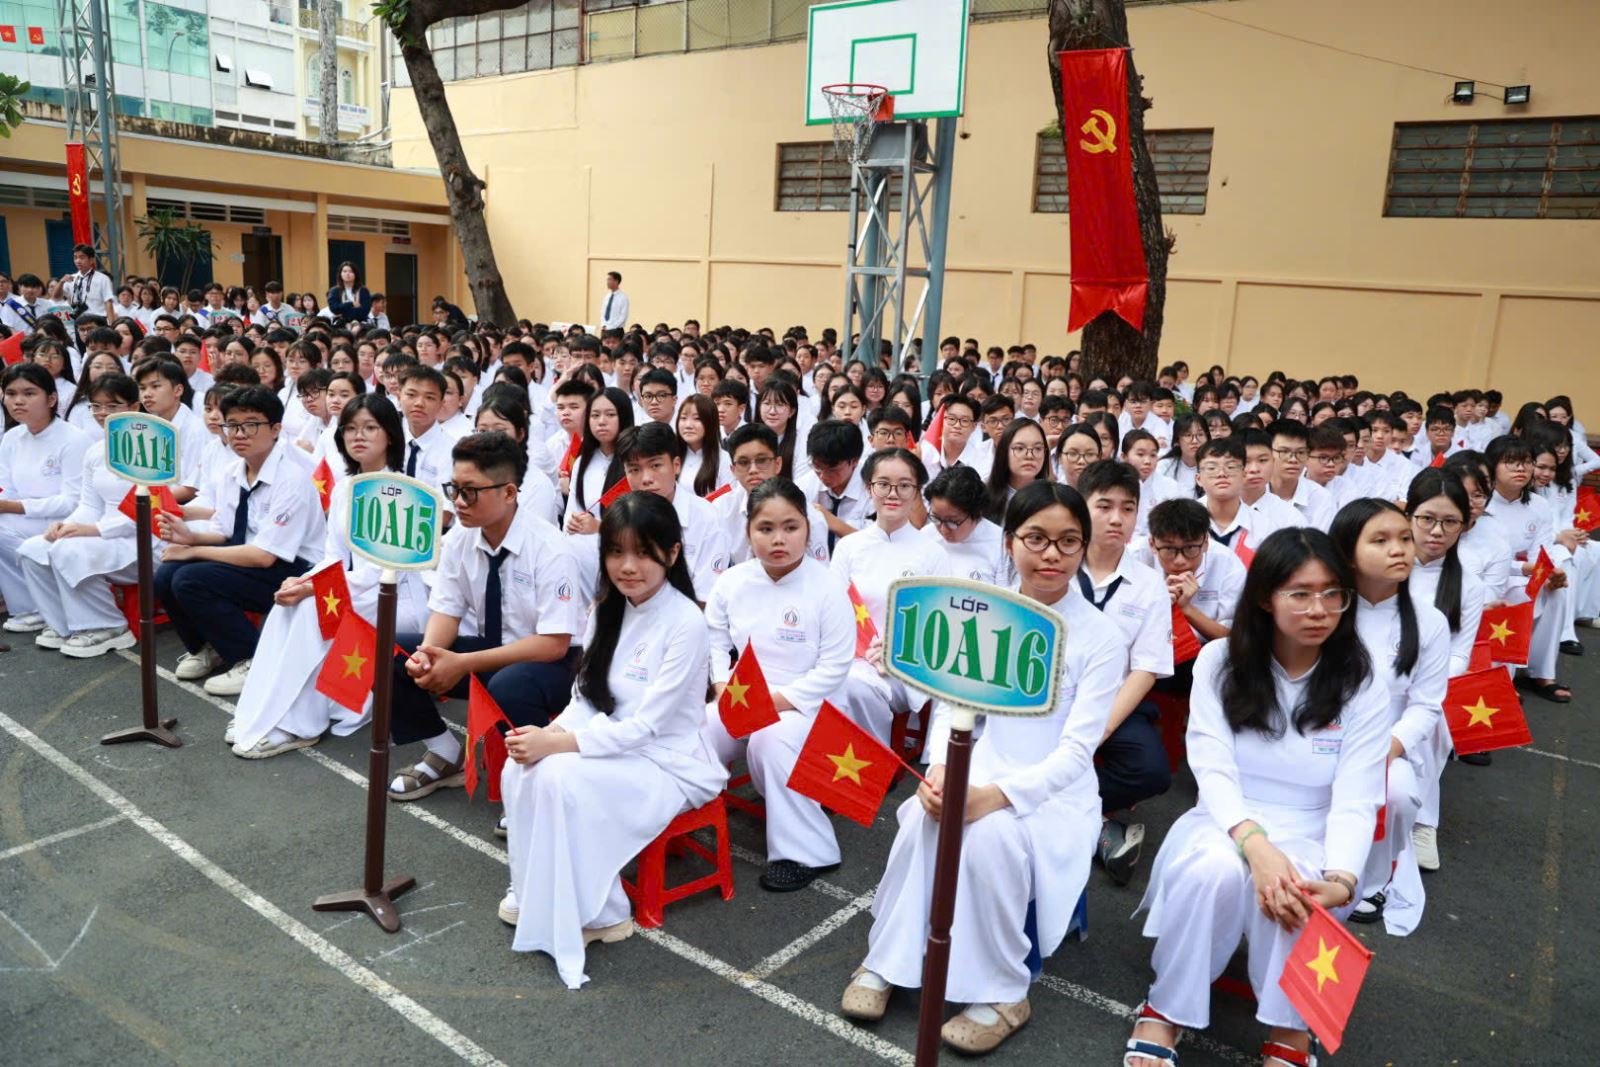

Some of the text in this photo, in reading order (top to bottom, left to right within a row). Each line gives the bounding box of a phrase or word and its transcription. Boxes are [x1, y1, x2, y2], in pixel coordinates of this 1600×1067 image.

[111, 430, 173, 472] 10A14
[352, 495, 433, 553] 10A15
[950, 595, 989, 614] LỚP
[896, 604, 1046, 696] 10A16
